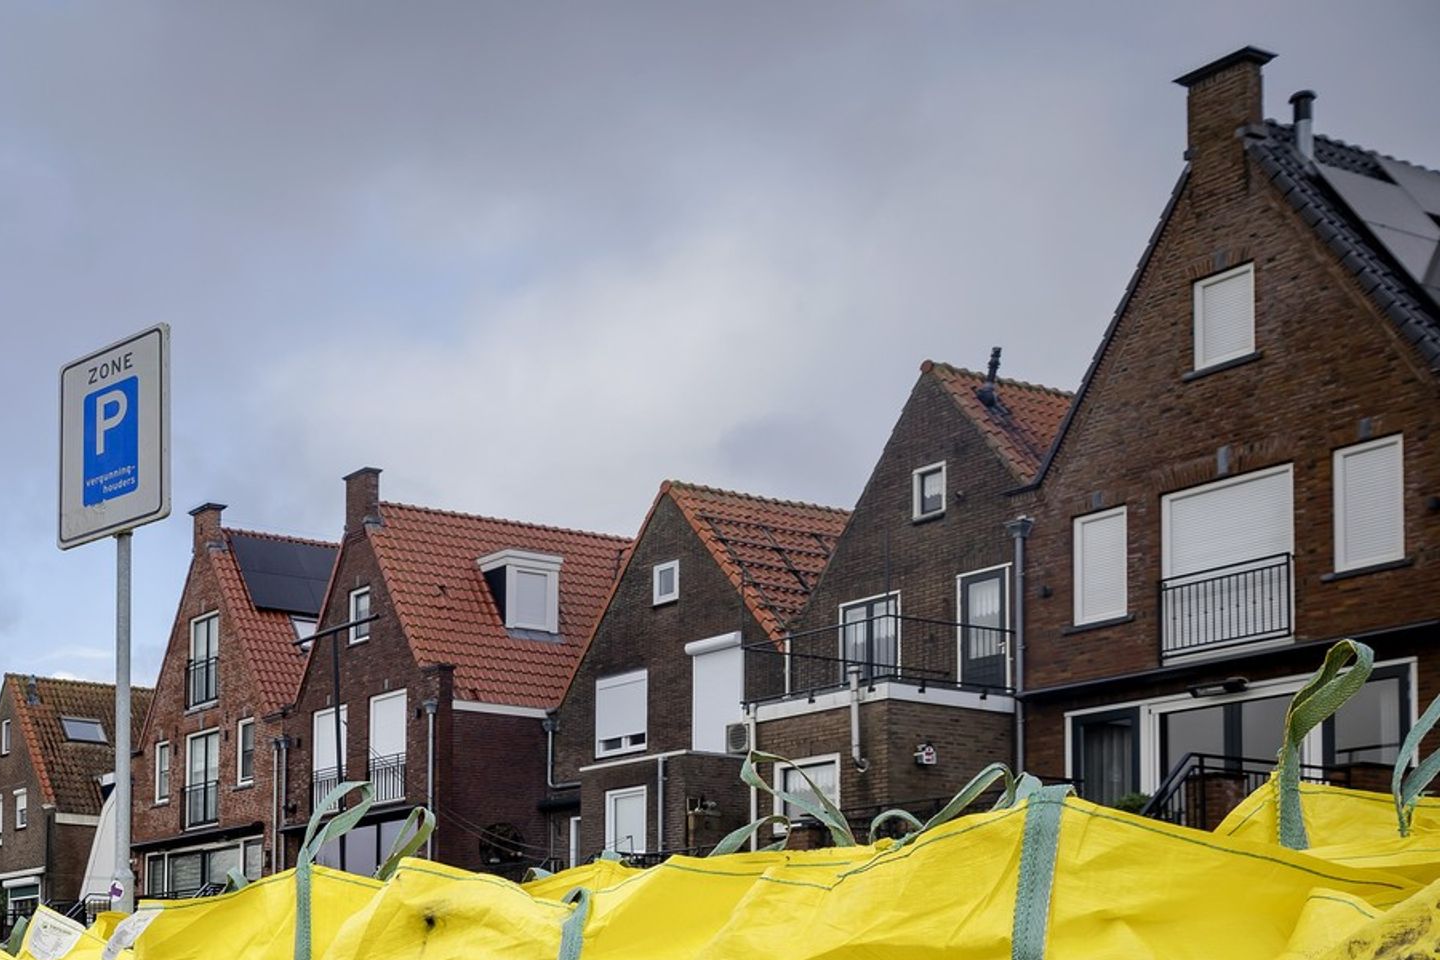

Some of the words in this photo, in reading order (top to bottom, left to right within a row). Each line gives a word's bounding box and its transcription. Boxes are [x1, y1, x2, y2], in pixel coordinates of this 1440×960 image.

[88, 352, 133, 385] ZONE
[95, 389, 128, 456] P
[86, 464, 136, 488] vergunning-
[102, 477, 136, 494] houders
